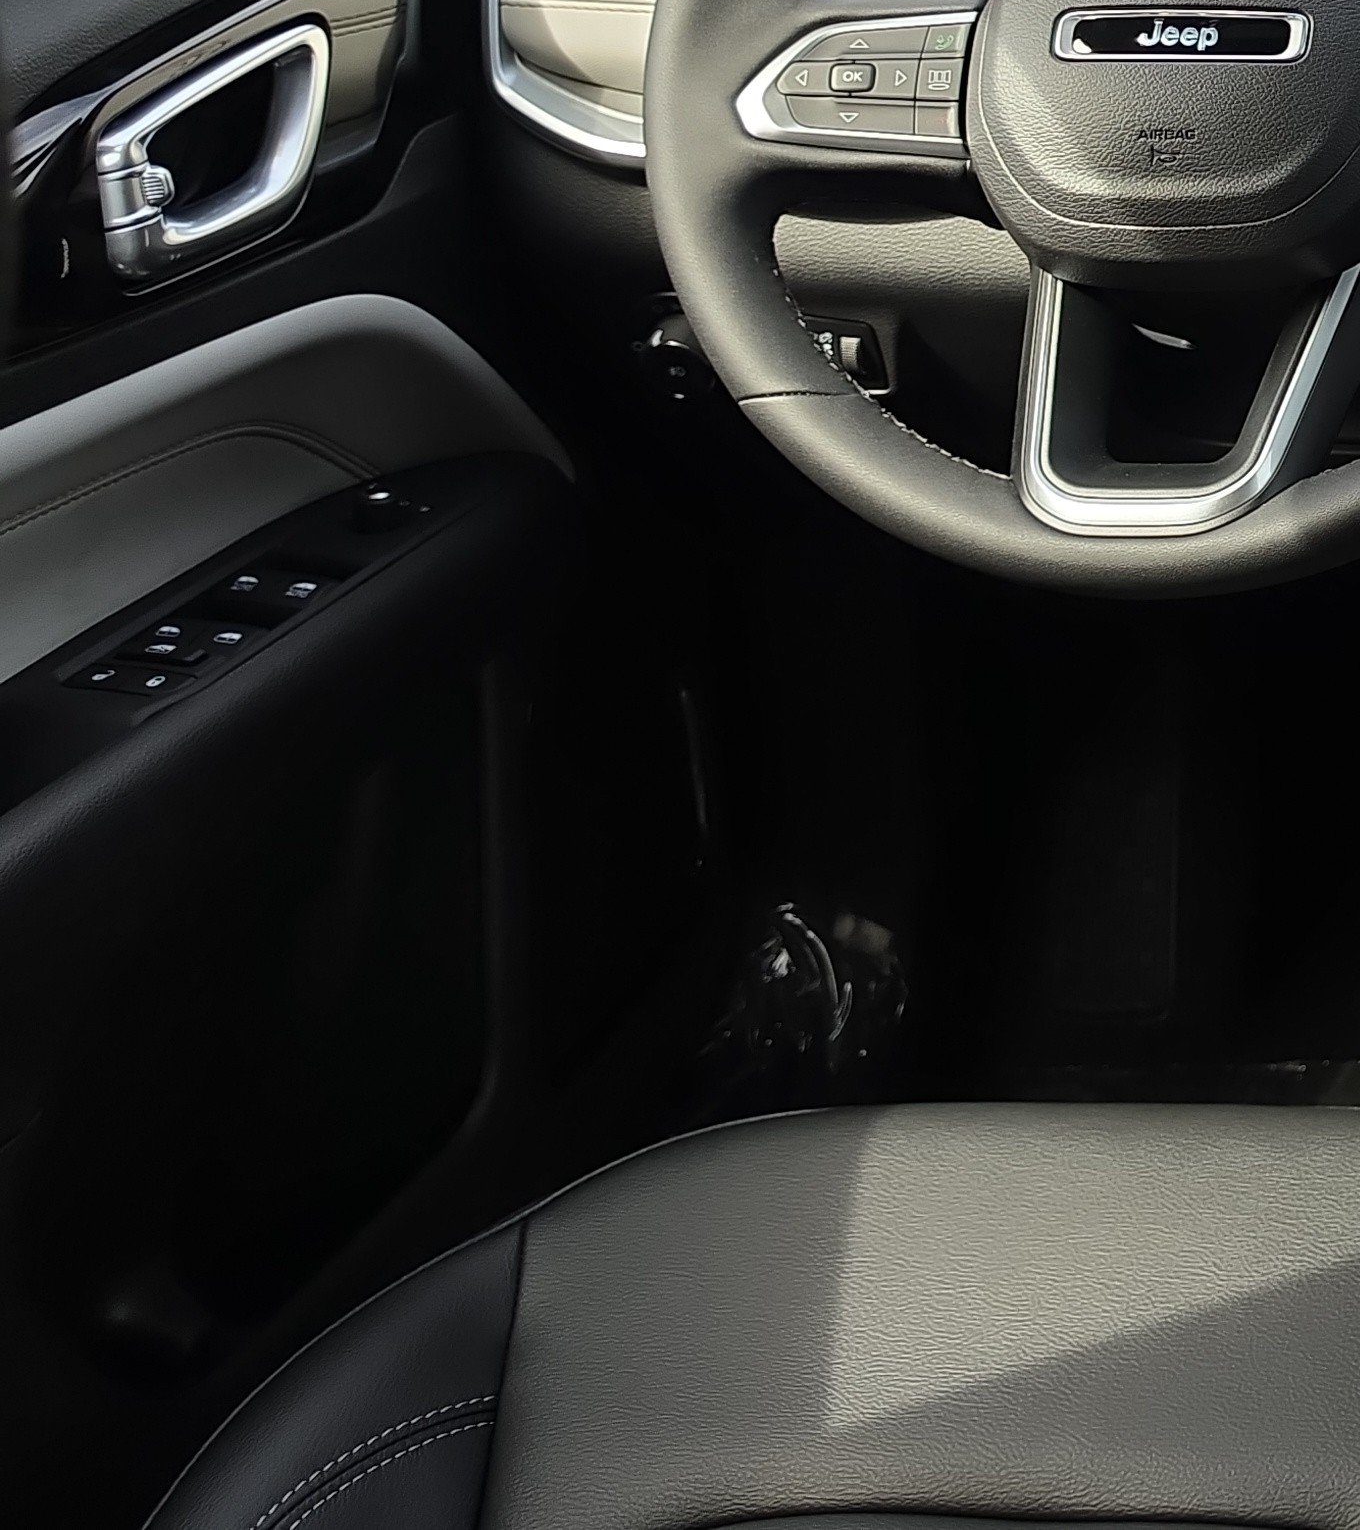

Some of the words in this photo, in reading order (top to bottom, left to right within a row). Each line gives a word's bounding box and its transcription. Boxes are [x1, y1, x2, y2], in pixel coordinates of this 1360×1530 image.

[1137, 18, 1219, 51] Jeep
[842, 71, 863, 83] OK
[1137, 128, 1197, 141] AIRBAG
